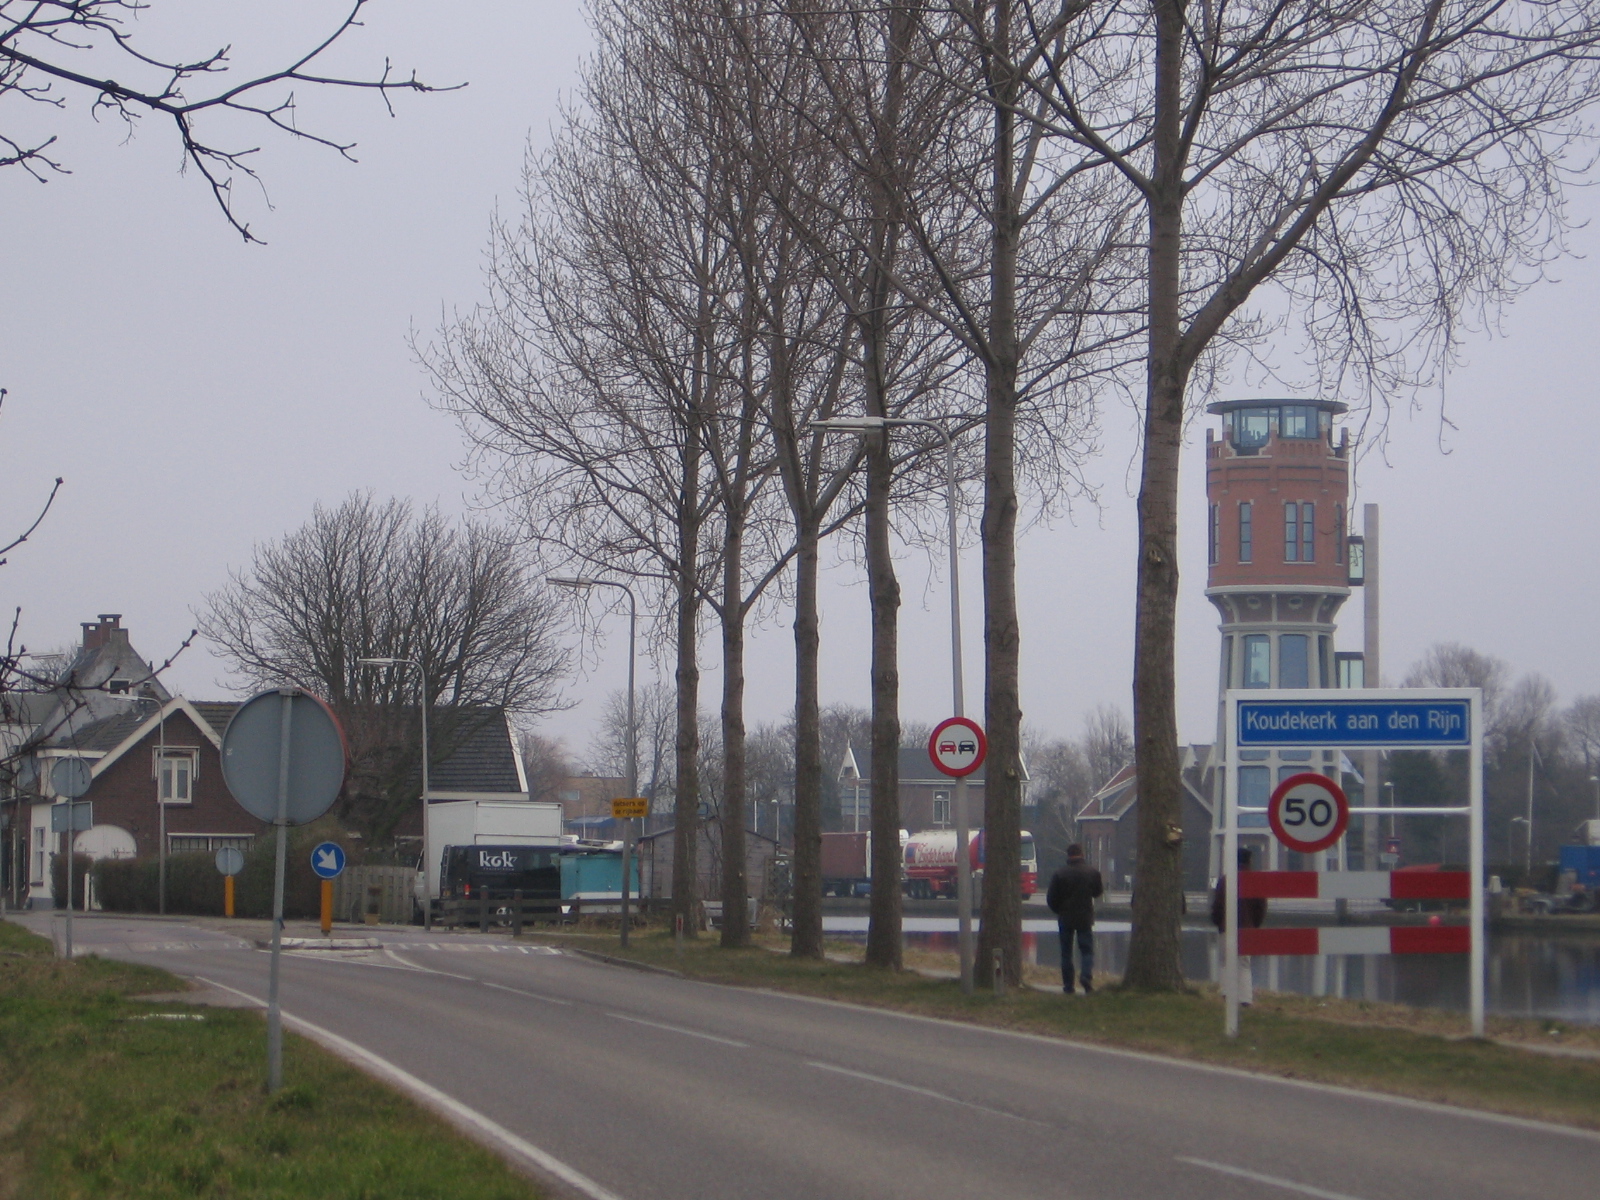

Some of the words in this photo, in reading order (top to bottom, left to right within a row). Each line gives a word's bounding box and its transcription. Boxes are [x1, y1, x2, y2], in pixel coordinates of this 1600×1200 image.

[1246, 711, 1337, 730] Koudekerk
[1347, 714, 1378, 729] aan
[1388, 711, 1419, 729] den
[1428, 710, 1460, 735] Rijn
[1284, 798, 1332, 827] 50
